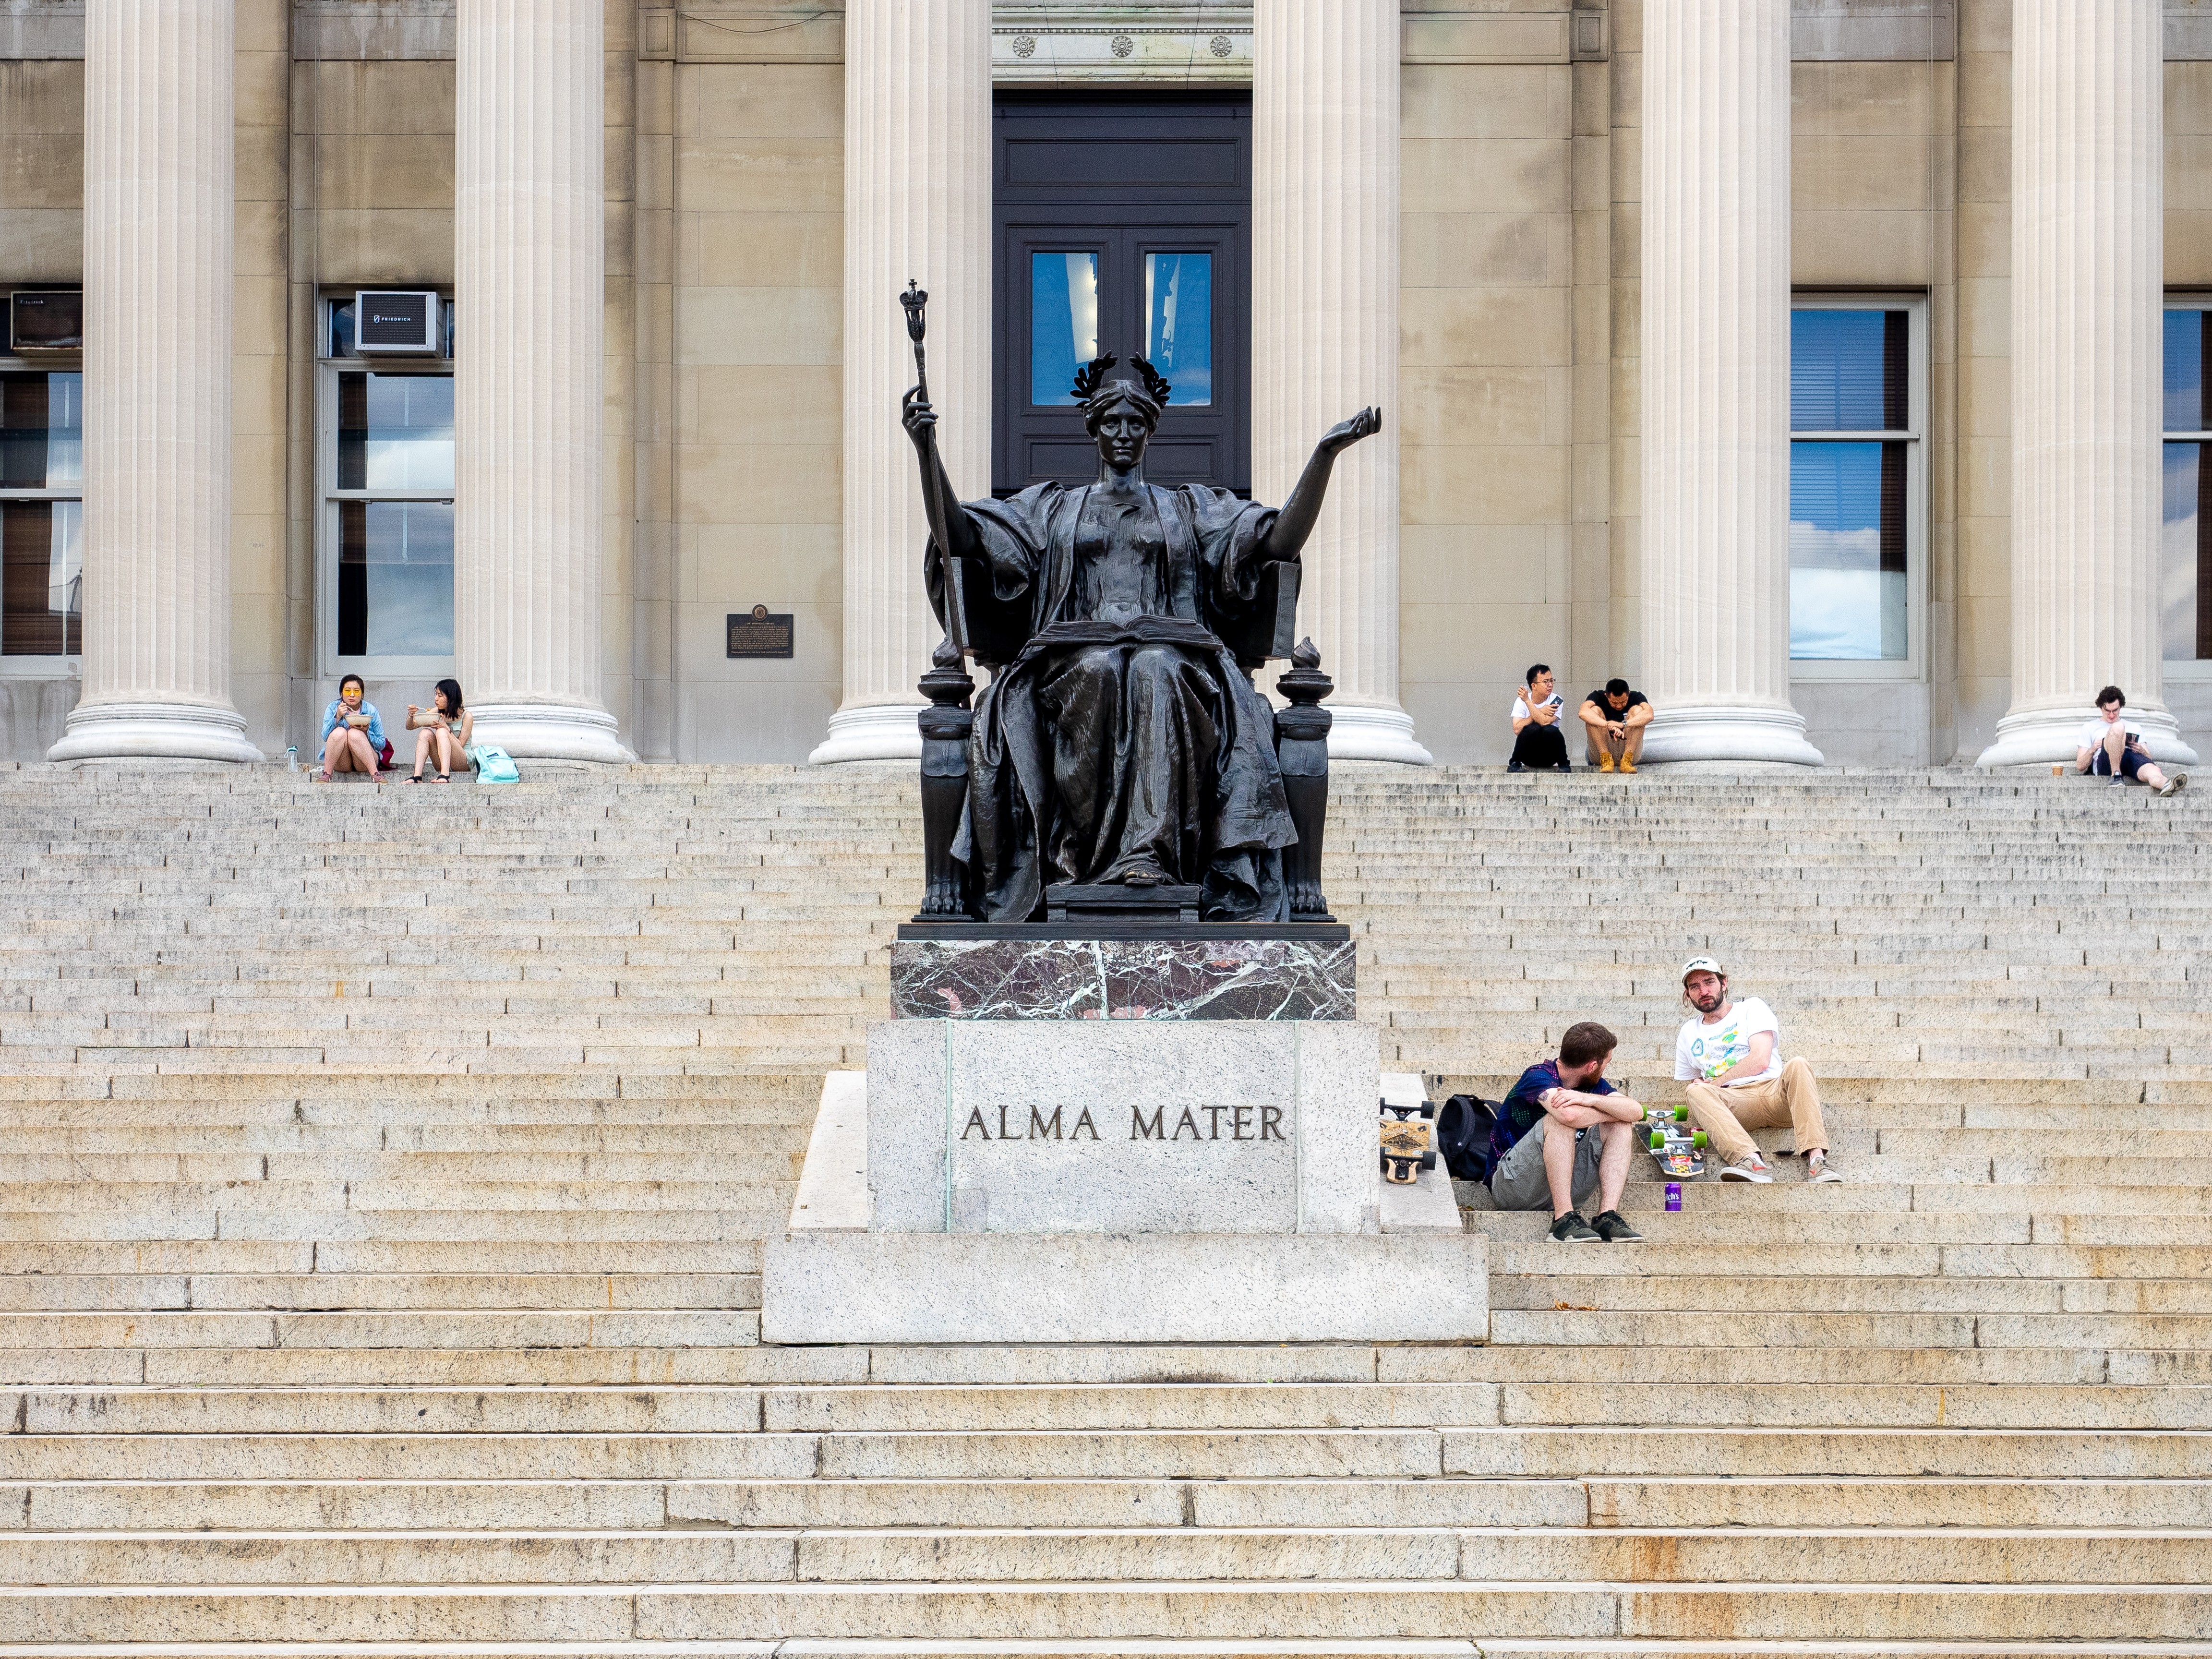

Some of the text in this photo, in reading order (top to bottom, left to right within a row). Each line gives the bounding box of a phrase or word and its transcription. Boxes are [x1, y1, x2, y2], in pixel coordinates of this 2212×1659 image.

[960, 1104, 1286, 1140] ALMA MATER
[1666, 1192, 1679, 1201] lch's
